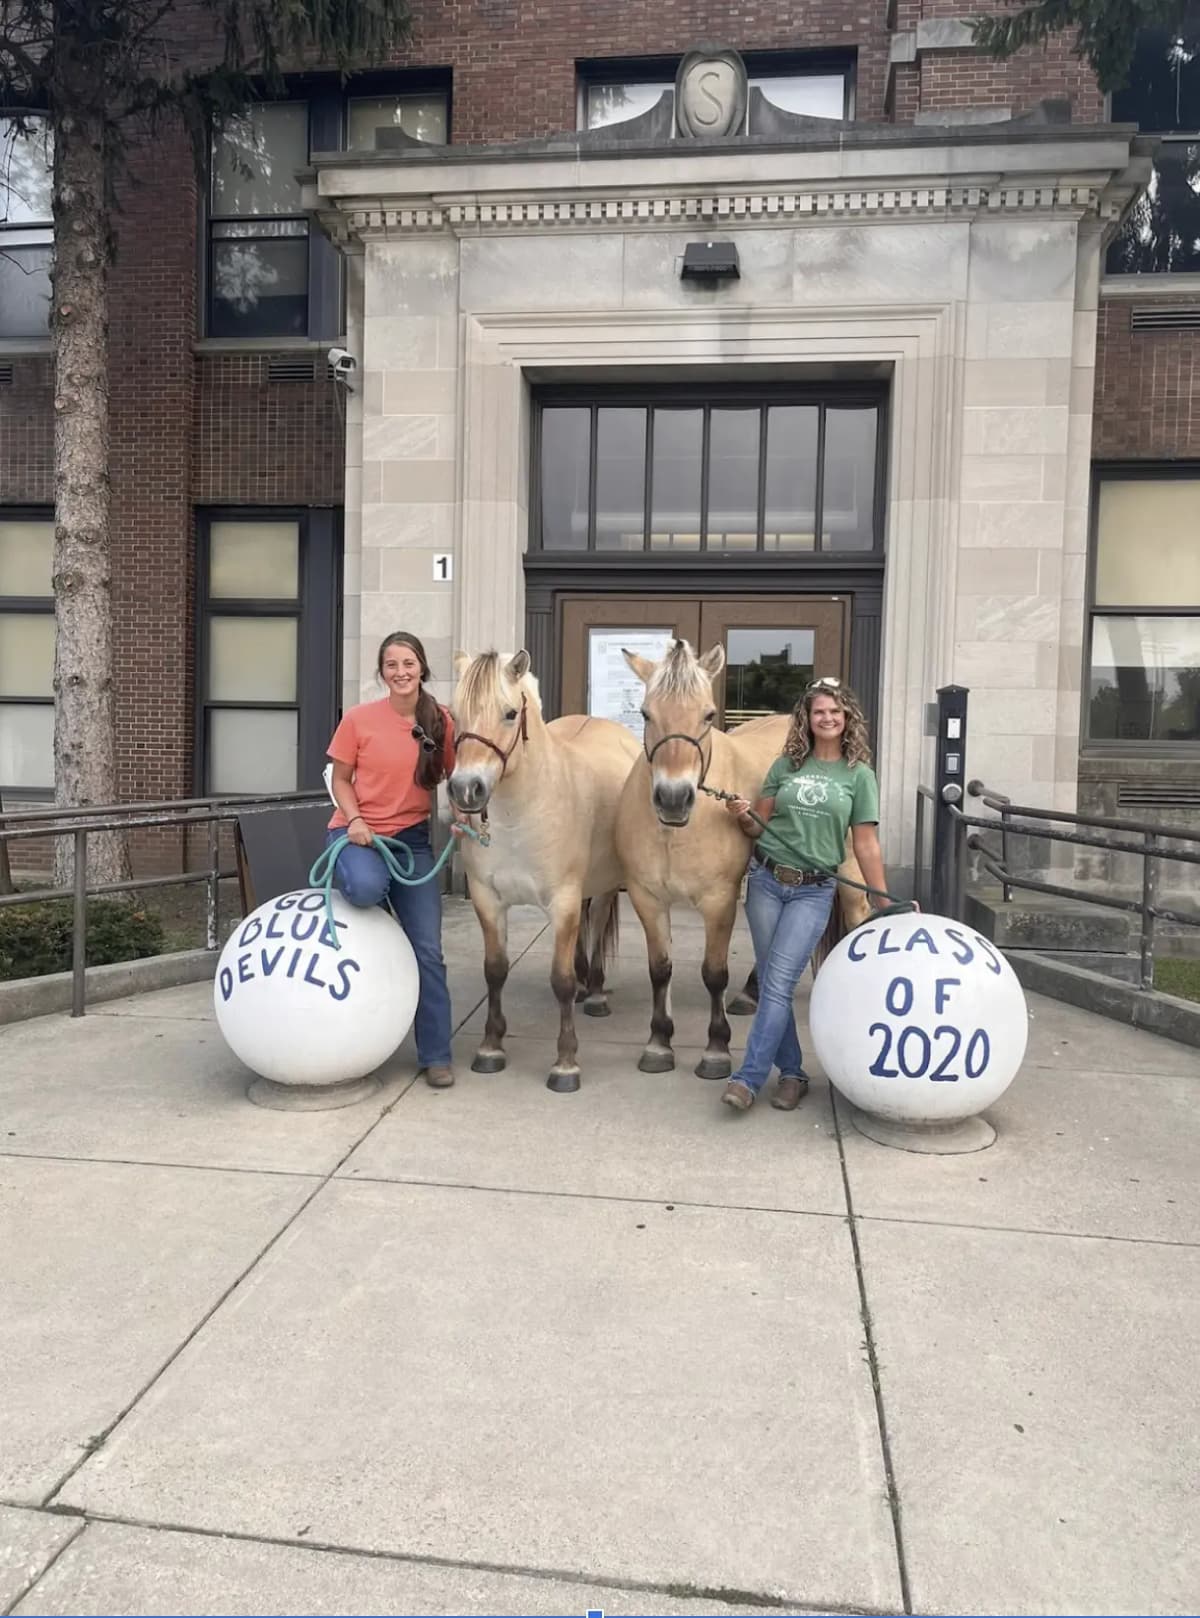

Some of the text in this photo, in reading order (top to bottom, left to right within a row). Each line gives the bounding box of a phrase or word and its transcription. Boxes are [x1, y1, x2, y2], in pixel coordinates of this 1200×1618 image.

[694, 71, 724, 126] S
[436, 556, 447, 579] 1
[275, 892, 326, 911] GO
[239, 912, 348, 949] BLUE
[847, 927, 1001, 975] CLASS
[219, 946, 360, 1001] DEVILS
[885, 976, 961, 1017] OF
[868, 1022, 990, 1082] 2020
